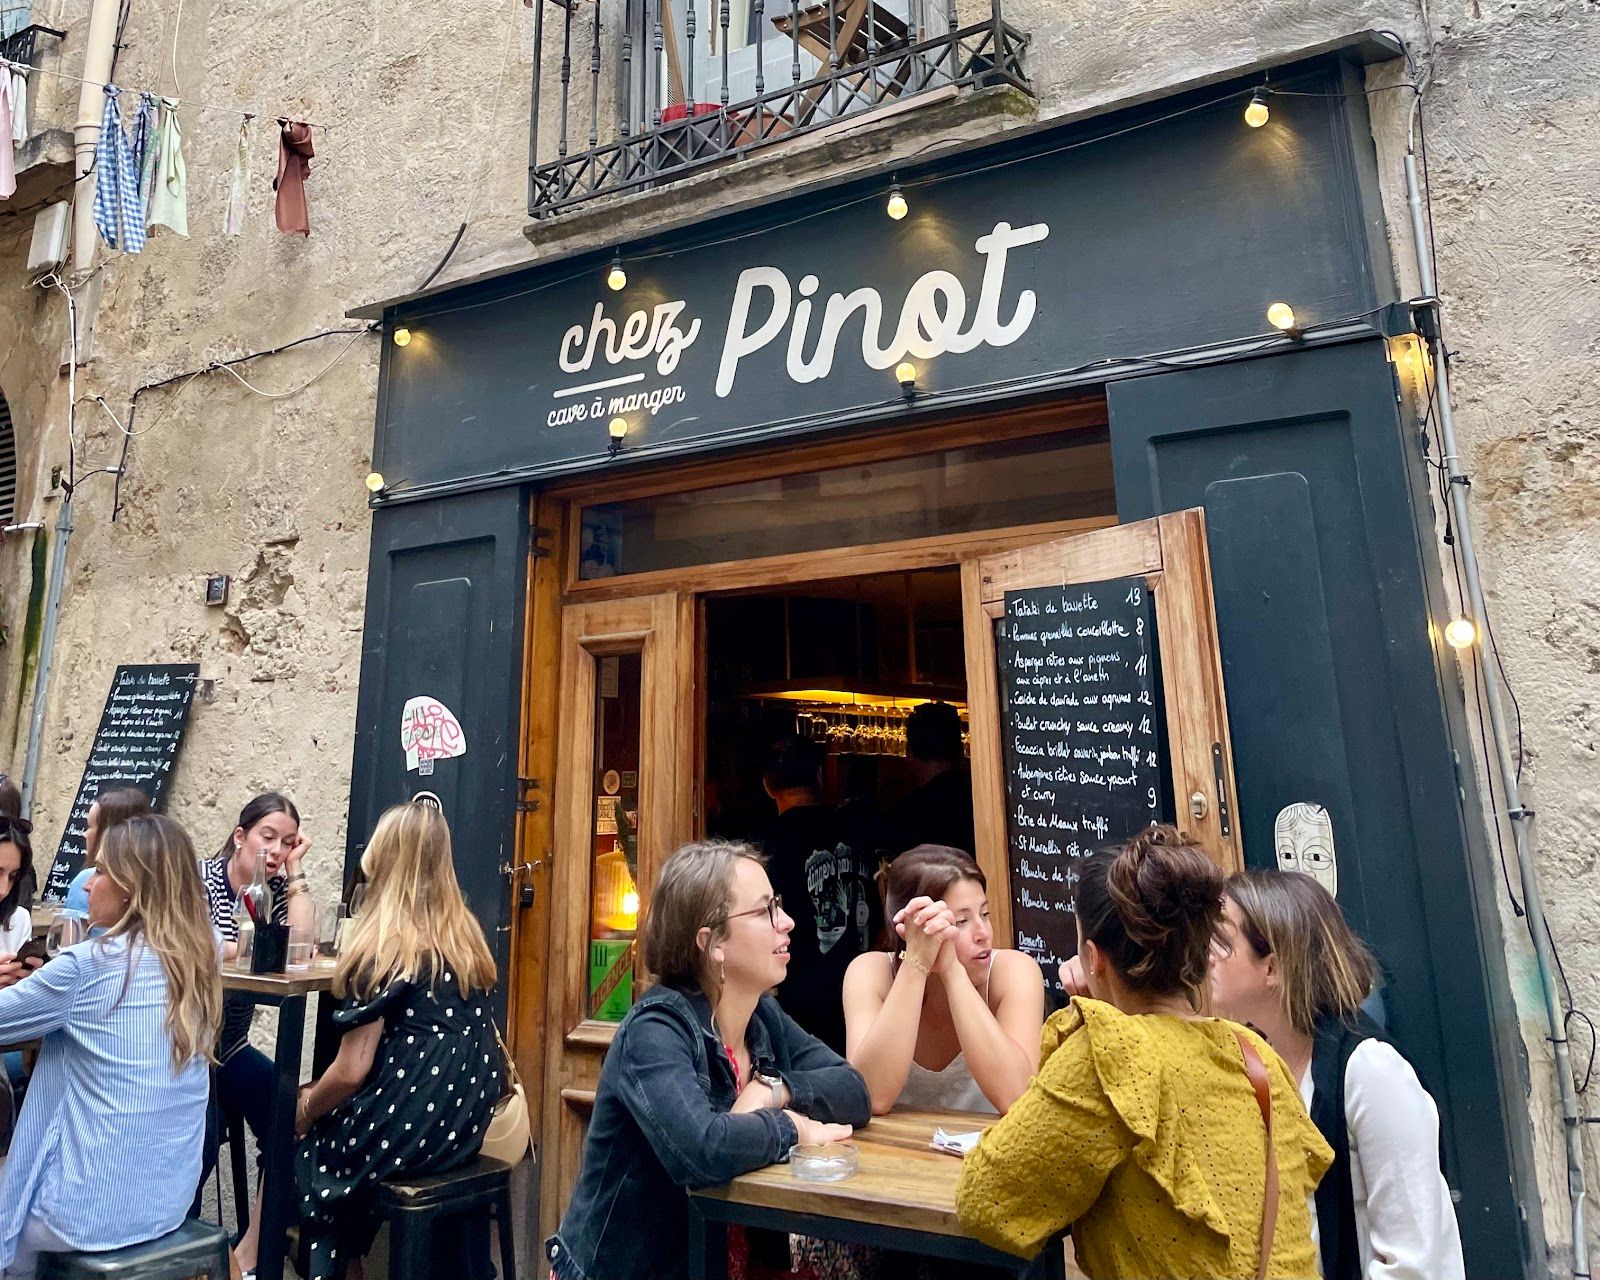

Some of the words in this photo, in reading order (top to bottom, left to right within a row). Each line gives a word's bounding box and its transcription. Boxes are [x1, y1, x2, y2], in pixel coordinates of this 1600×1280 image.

[558, 301, 701, 375] chez
[715, 222, 1049, 398] Pinot
[547, 399, 588, 427] cave
[590, 396, 607, 419] à
[608, 382, 686, 424] manger
[1012, 598, 1040, 617] Tataki
[1045, 600, 1057, 613] de
[1062, 593, 1099, 613] bavette
[1125, 587, 1141, 606] 13
[1012, 622, 1038, 642] Pommes
[1136, 617, 1144, 636] 8
[1014, 650, 1043, 673] Asperges
[1068, 656, 1084, 666] aux
[1134, 653, 1147, 676] 11
[1016, 676, 1030, 685] aux
[1054, 672, 1063, 685] et
[1065, 673, 1071, 684] à
[1039, 692, 1048, 705] de
[1050, 692, 1080, 707] daurade
[1083, 695, 1099, 705] aux
[1102, 692, 1131, 711] agrumes
[1137, 690, 1152, 706] 12
[1015, 712, 1038, 730] Poulet
[1040, 717, 1071, 735] crunchy
[1077, 721, 1100, 733] sauce
[1102, 720, 1134, 739] creamy
[1138, 713, 1152, 734] 12
[1015, 735, 1045, 756] Focaccia
[1146, 750, 1157, 767] 12
[1080, 770, 1107, 785] sauce
[1107, 769, 1138, 792] yaourt
[1021, 784, 1031, 798] et
[1033, 790, 1056, 806] curry
[1147, 787, 1157, 808] 9
[1018, 804, 1035, 827] Brie
[1037, 813, 1047, 827] de
[1049, 813, 1078, 831] Meaux
[1018, 834, 1028, 851] St
[1020, 858, 1049, 881] Planche
[1052, 865, 1064, 882] de
[1021, 887, 1050, 911] Planche
